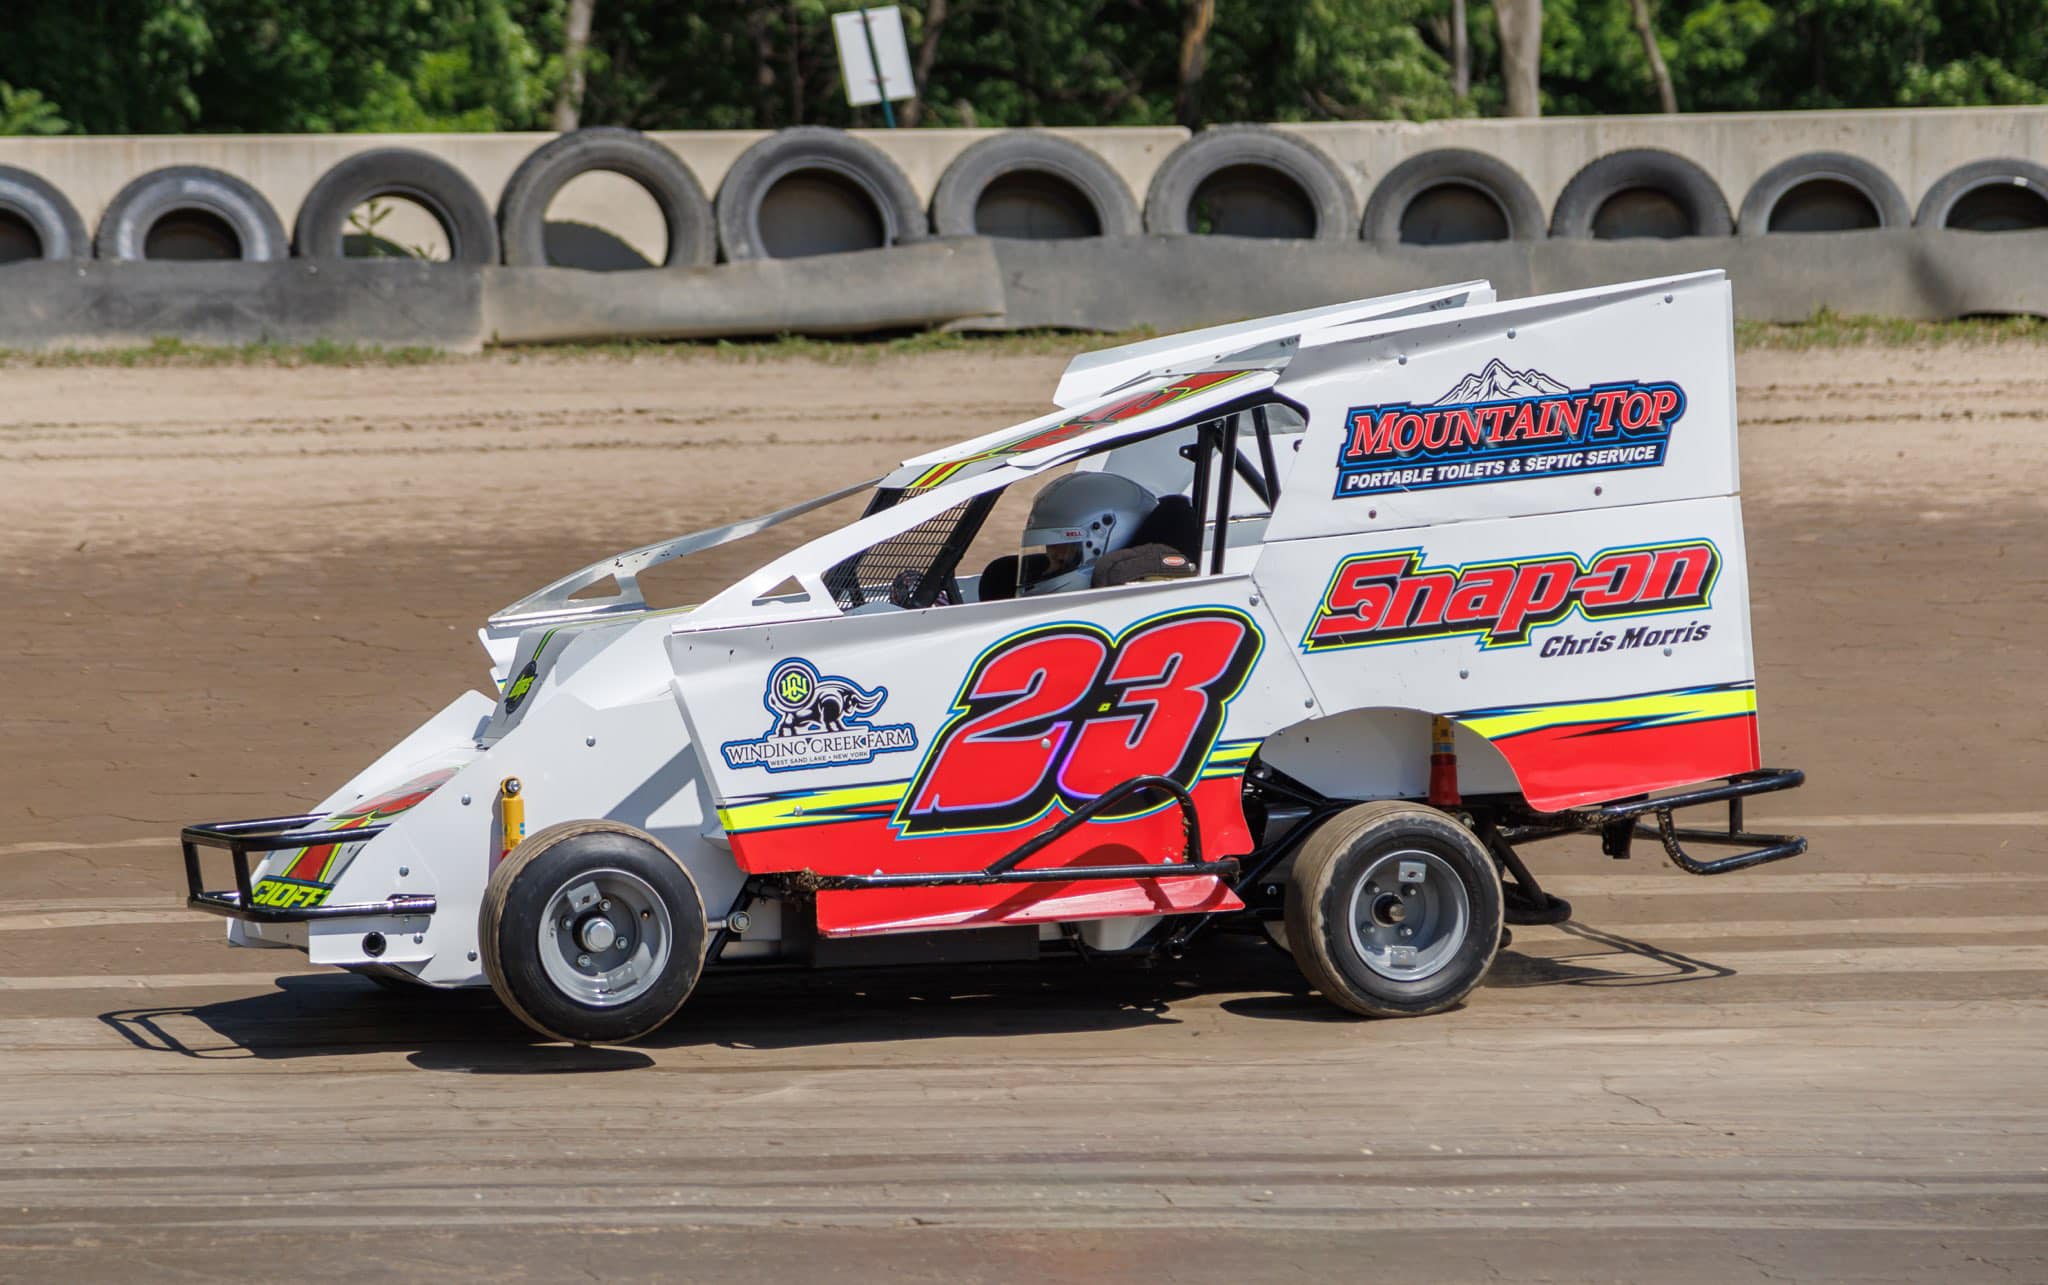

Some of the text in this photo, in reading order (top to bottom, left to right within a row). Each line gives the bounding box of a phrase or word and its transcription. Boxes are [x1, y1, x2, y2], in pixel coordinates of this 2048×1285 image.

[1347, 389, 1679, 457] MOUNTAIN TOP
[1346, 445, 1657, 490] PORTABLE TOILETS & SEPTIC SERVICE
[1309, 543, 1714, 640] Snap-on
[1539, 620, 1712, 658] Chris Morris
[904, 613, 1250, 822] 23
[727, 728, 912, 763] WINDING CREEK FARM
[770, 758, 789, 767] WEST
[790, 756, 808, 764] SAND
